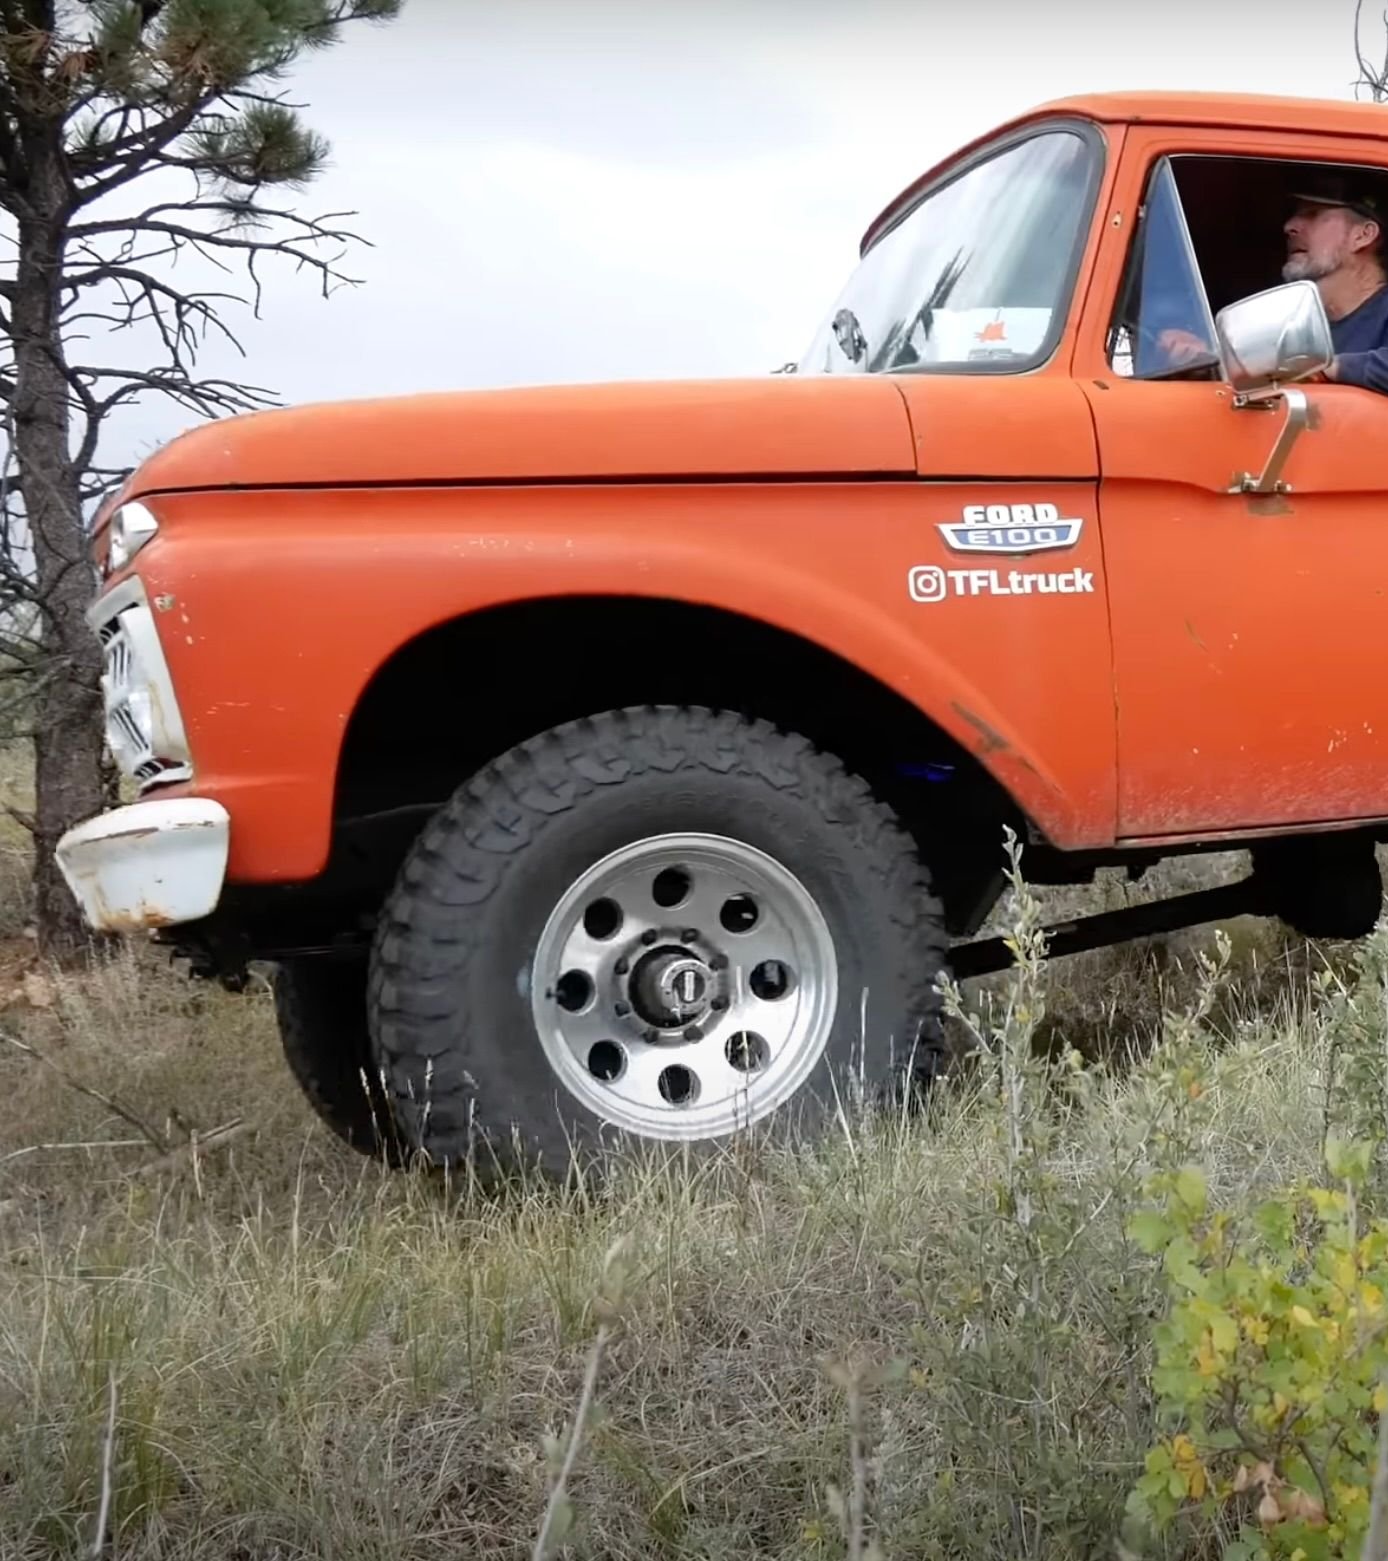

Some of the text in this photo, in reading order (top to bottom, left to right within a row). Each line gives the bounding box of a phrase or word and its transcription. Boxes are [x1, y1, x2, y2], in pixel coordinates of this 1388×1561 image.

[963, 503, 1059, 526] FORD
[968, 528, 1058, 545] E100
[947, 567, 1094, 596] TFLtruck
